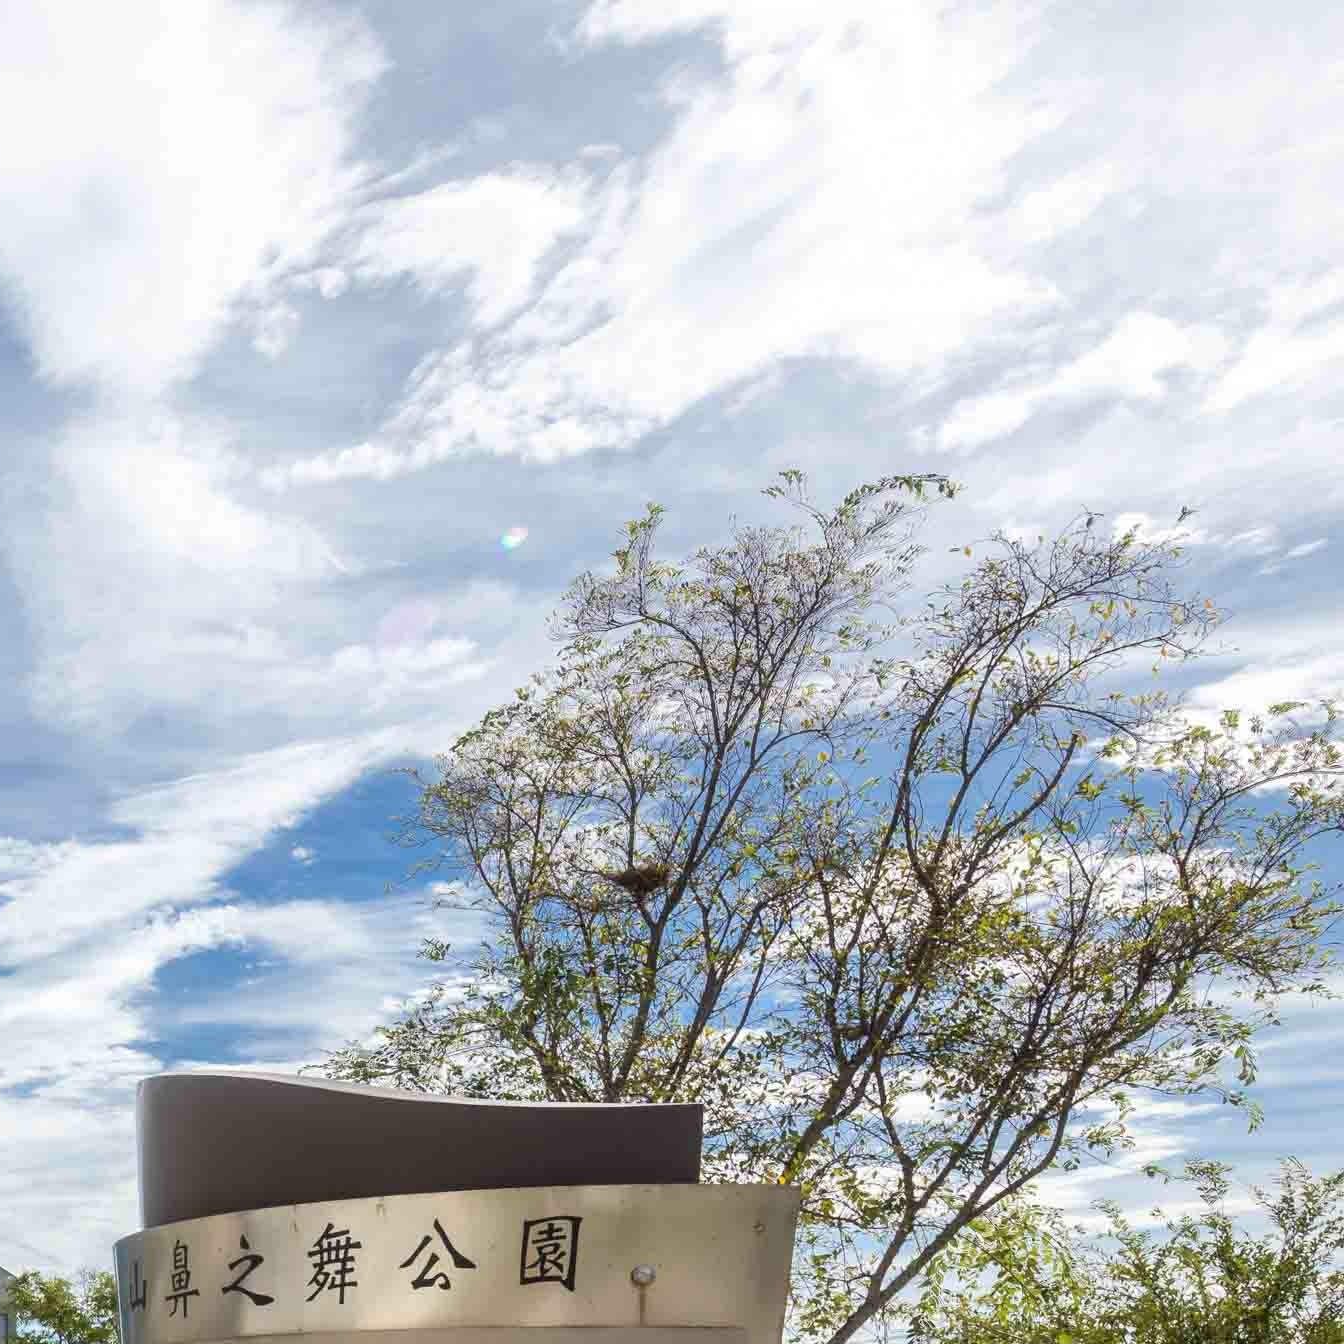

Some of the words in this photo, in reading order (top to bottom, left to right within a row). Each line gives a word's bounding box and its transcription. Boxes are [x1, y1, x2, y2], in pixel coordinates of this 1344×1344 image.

[129, 1216, 583, 1319] 山鼻之舞公園
